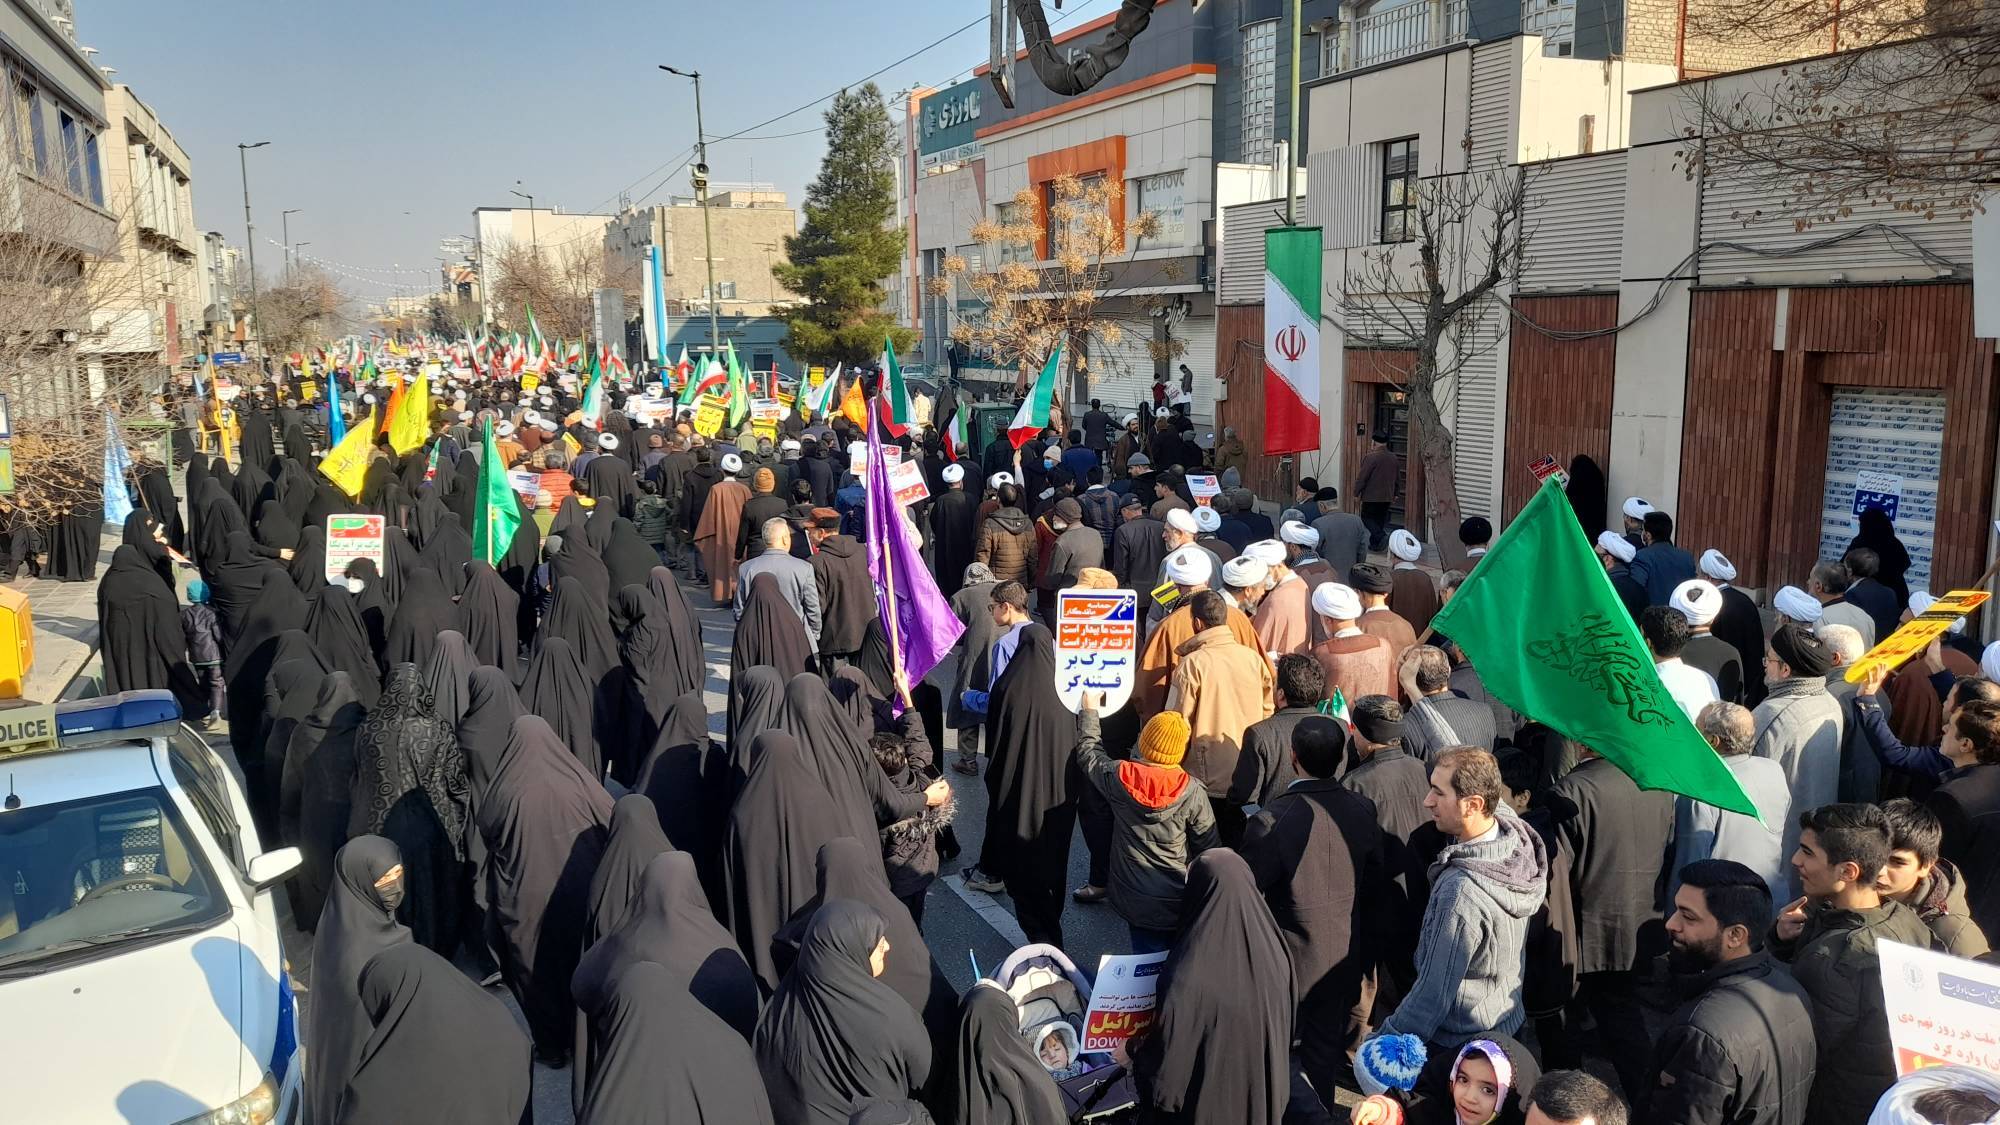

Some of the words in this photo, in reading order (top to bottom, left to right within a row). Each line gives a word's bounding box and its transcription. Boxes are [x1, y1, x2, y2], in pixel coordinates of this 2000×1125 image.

[1064, 655, 1078, 670] بر
[1080, 652, 1127, 671] مرگ
[1082, 672, 1122, 688] فتنه
[0, 719, 48, 742] OLICE
[1090, 1012, 1154, 1035] سرائیل
[1088, 1037, 1122, 1048] DOW
